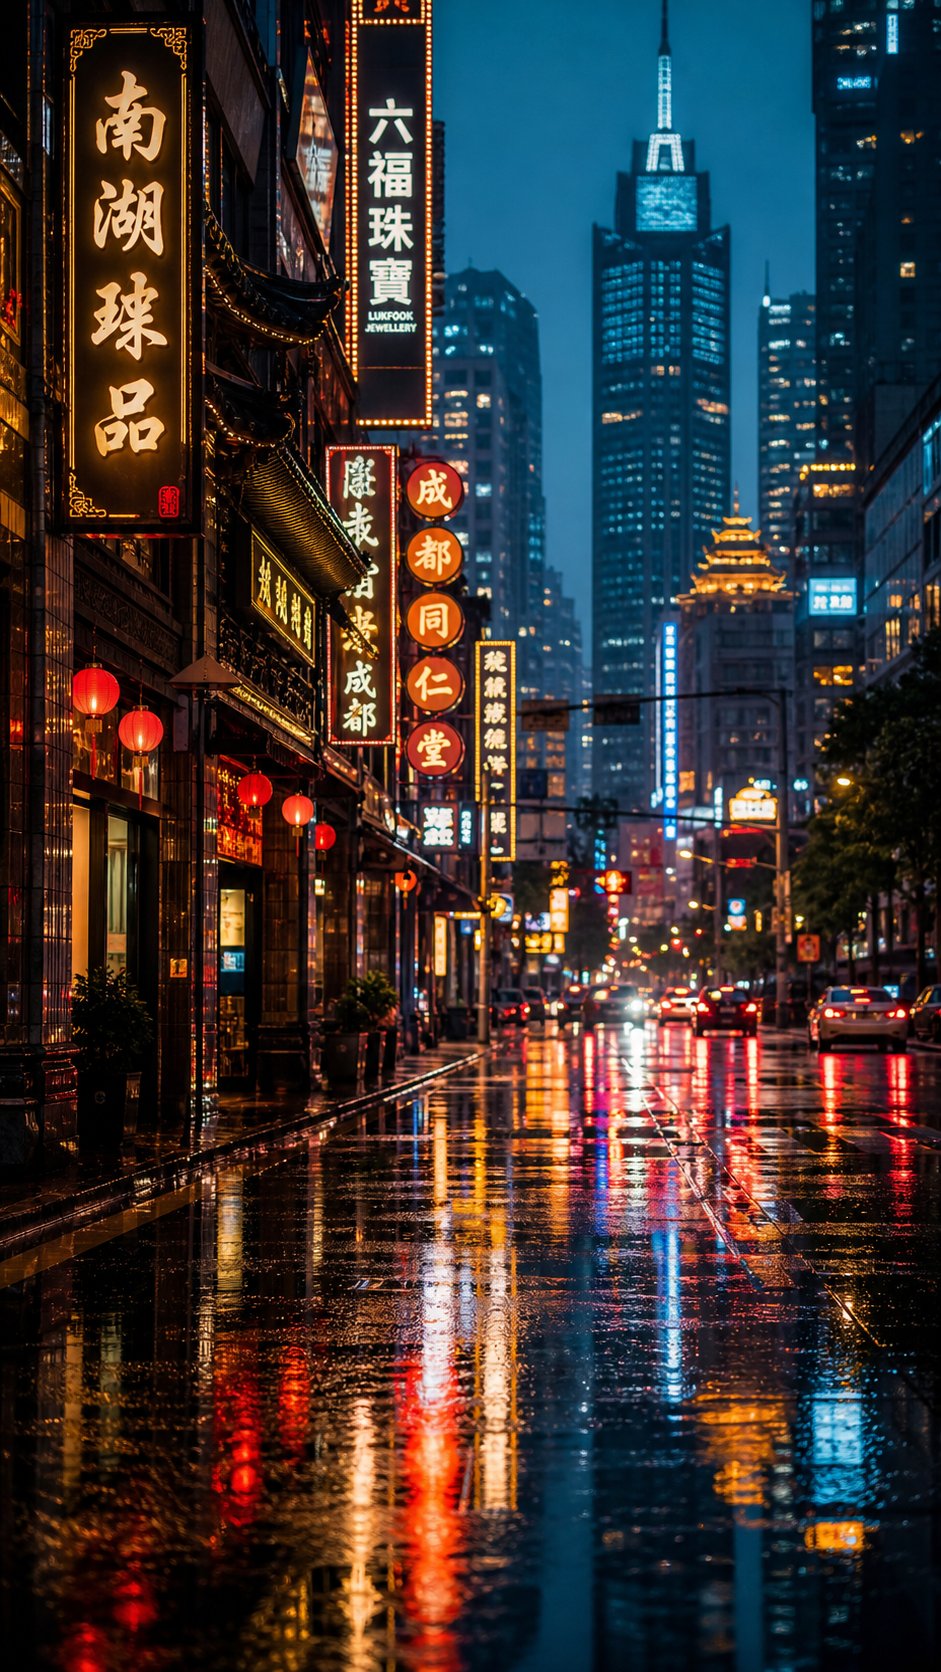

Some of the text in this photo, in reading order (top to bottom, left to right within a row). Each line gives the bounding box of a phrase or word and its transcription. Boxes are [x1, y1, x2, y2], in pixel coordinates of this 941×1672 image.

[367, 97, 414, 306] 六福珠寶
[364, 323, 417, 333] JEWELLERY
[367, 311, 414, 321] LUKFOOK
[414, 468, 455, 768] 成都同仁堂
